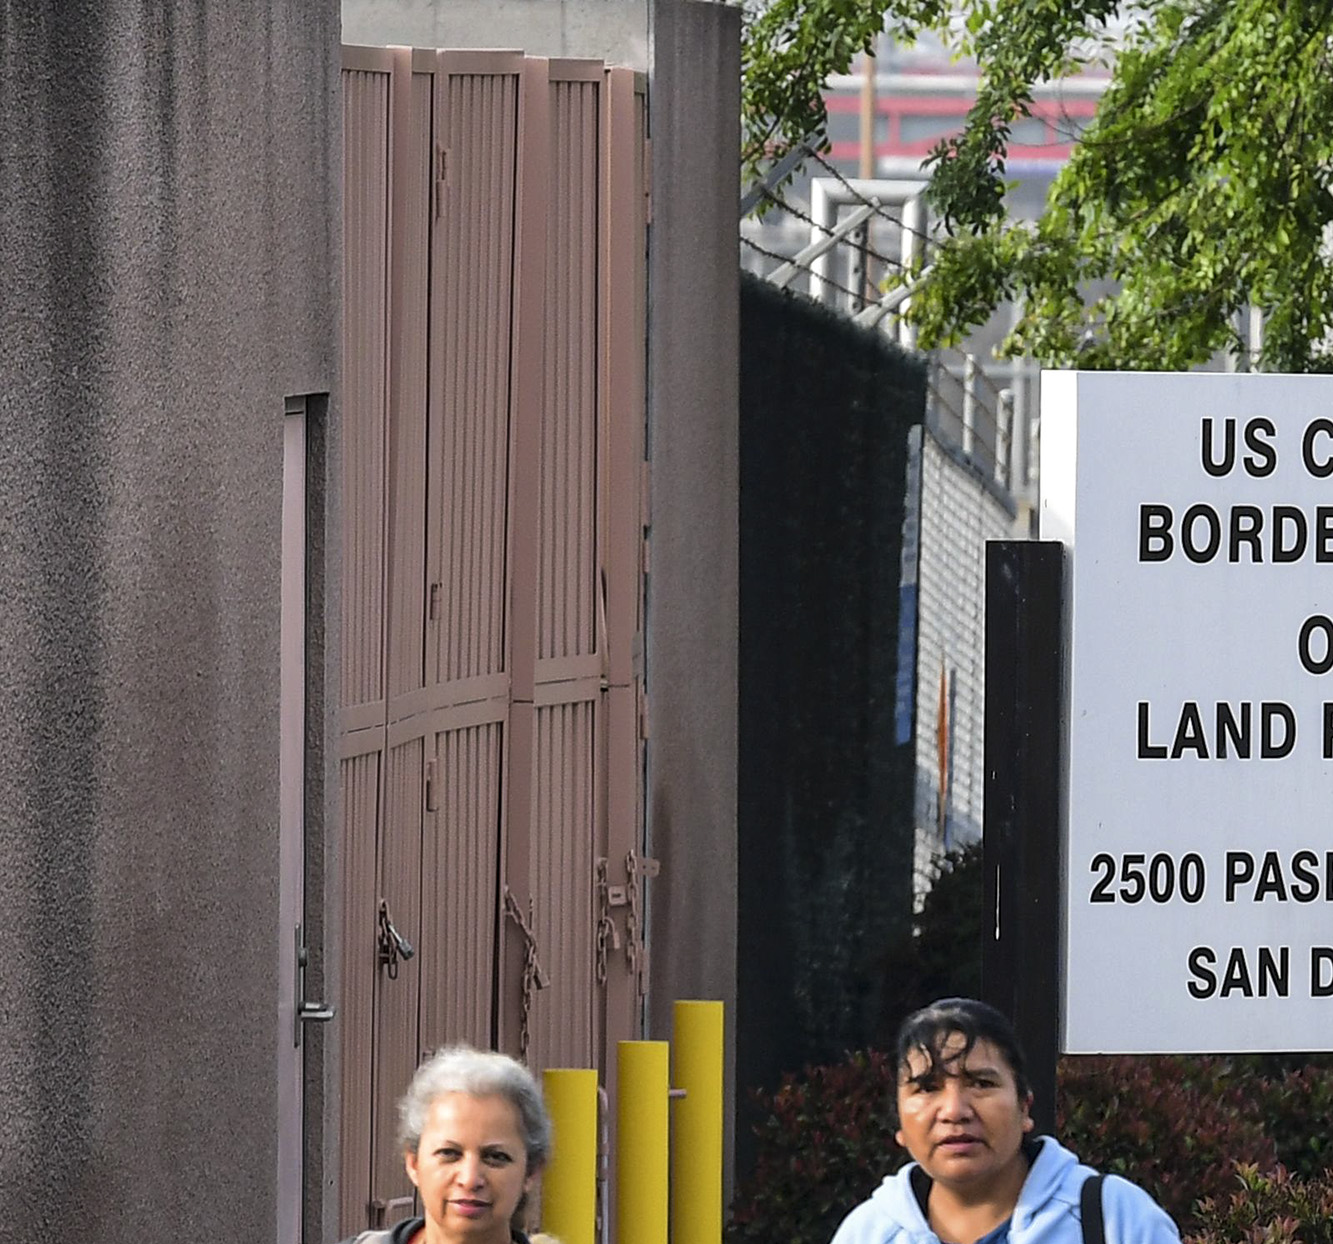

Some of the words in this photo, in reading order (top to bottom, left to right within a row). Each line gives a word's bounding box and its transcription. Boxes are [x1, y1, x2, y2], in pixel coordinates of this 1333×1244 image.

[1201, 417, 1277, 478] US
[1137, 702, 1296, 760] LAND
[1089, 852, 1205, 904] 2500
[1187, 946, 1289, 1000] SAN
